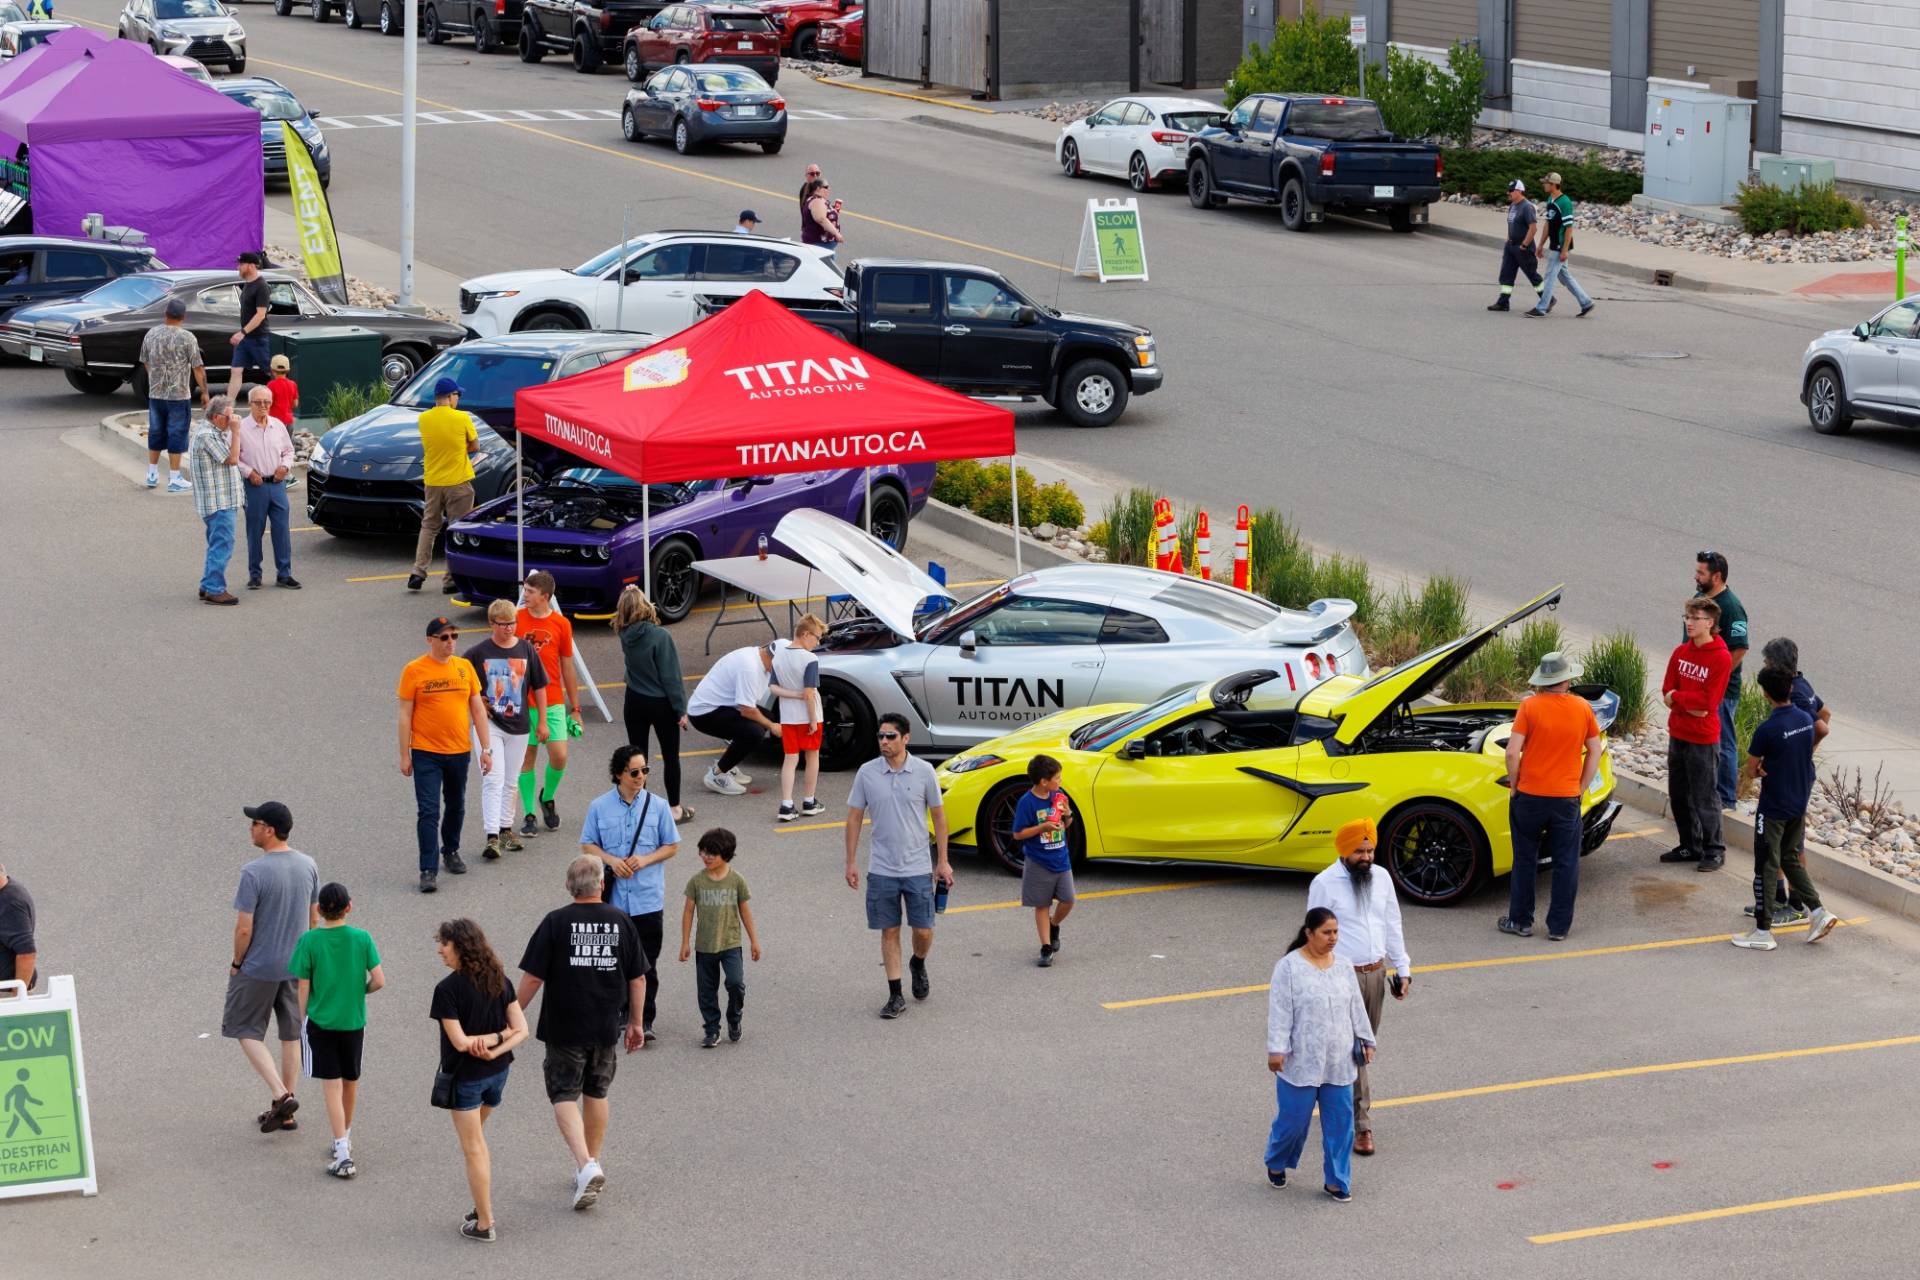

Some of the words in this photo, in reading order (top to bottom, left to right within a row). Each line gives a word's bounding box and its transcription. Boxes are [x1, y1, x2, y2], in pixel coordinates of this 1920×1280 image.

[294, 162, 326, 255] EVENT
[1097, 214, 1135, 226] SLOW
[723, 356, 871, 390] TITAN
[749, 382, 866, 400] AUTOMOTIVE
[544, 412, 613, 460] TITANAUTO.CA
[735, 430, 927, 466] TITANAUTO.CA
[1678, 658, 1709, 679] TITAN
[948, 676, 1064, 708] TITAN
[958, 711, 1047, 721] AUTOMOTIV
[570, 922, 611, 934] THAT'S
[613, 923, 620, 934] A
[570, 932, 620, 947] HORRIBLE
[569, 956, 593, 967] WHAT
[592, 956, 618, 967] TIME?
[0, 1025, 56, 1051] OW
[0, 1142, 71, 1161] DESTRIAN
[0, 1158, 59, 1175] TRAFFIC
